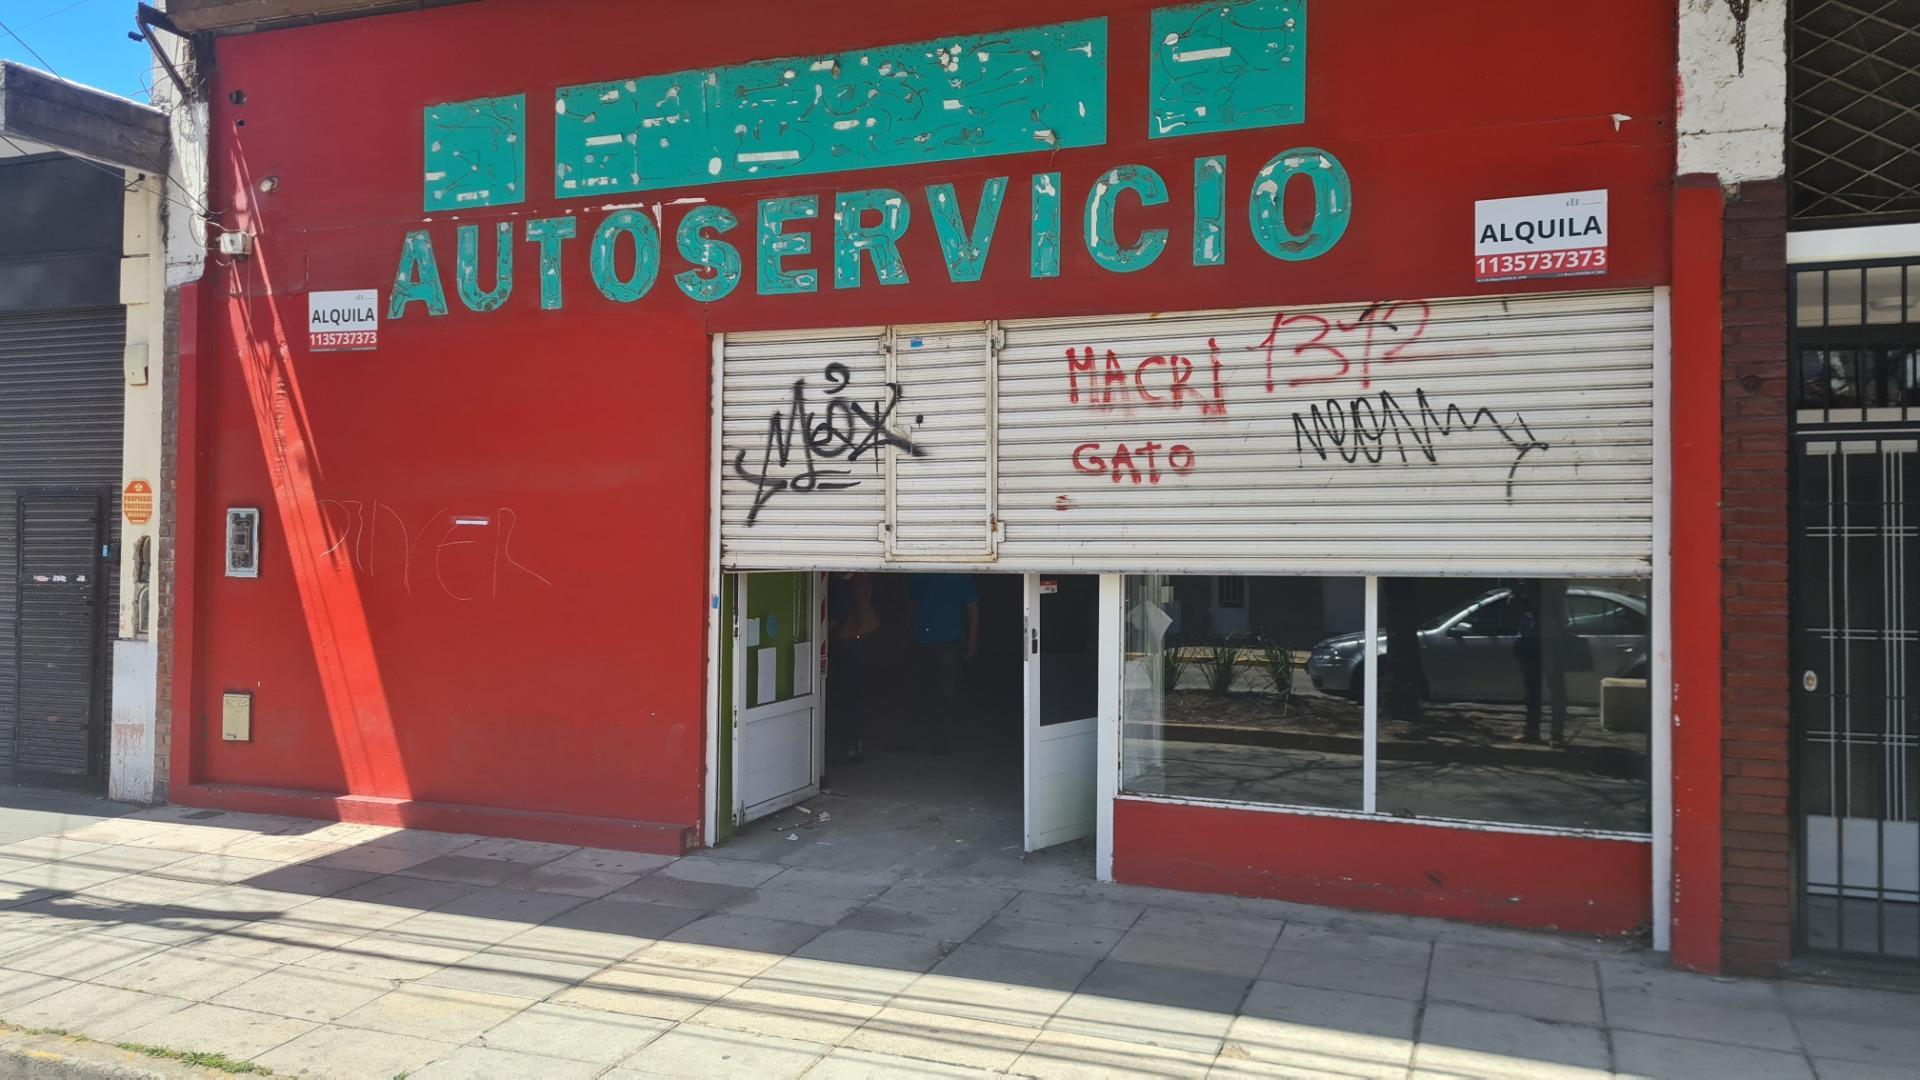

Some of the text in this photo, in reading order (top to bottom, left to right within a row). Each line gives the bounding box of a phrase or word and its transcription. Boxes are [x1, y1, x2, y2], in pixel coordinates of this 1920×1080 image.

[387, 146, 1352, 319] AUTOSERVICIO
[1479, 215, 1602, 244] ALQUILA
[1476, 249, 1607, 274] 1135737373
[311, 307, 375, 326] ALQUILA
[309, 331, 377, 346] 1135737373
[1072, 441, 1196, 485] GATO
